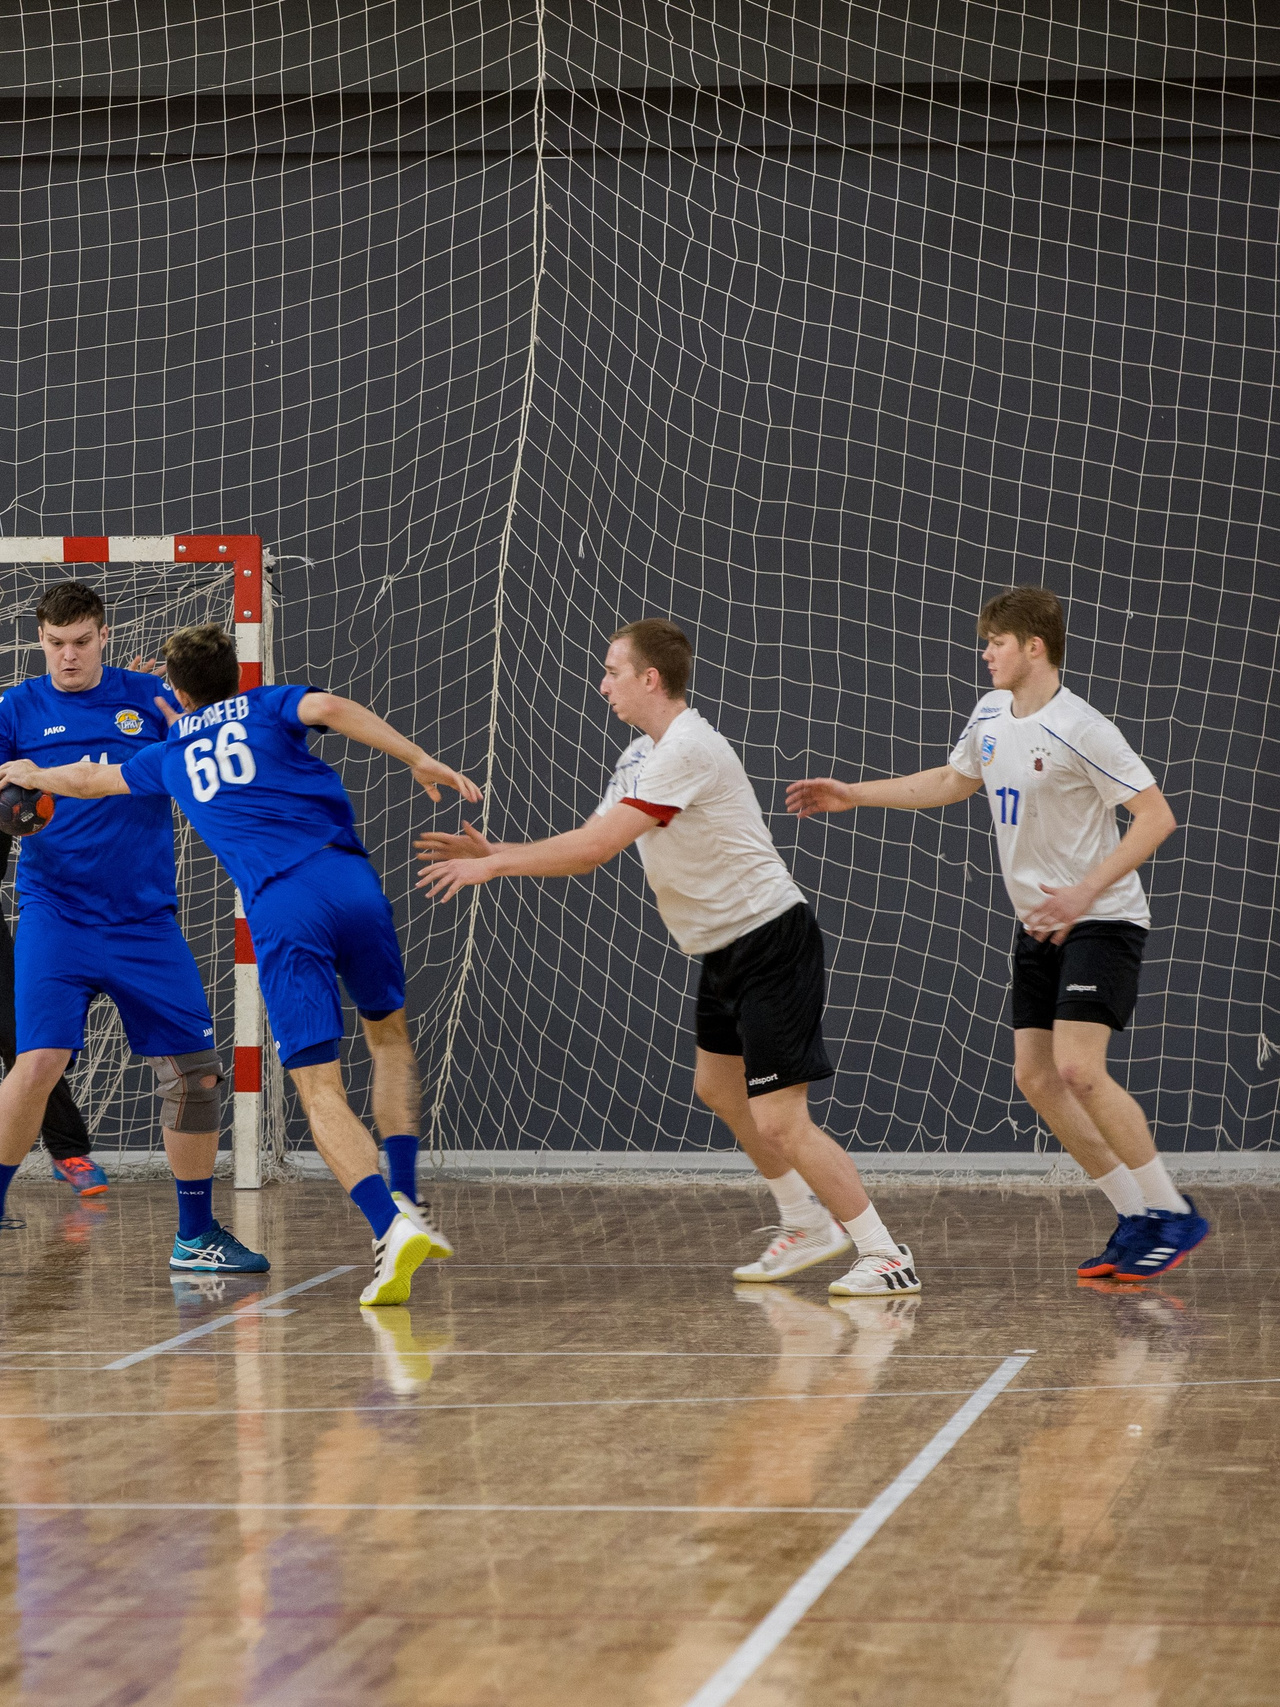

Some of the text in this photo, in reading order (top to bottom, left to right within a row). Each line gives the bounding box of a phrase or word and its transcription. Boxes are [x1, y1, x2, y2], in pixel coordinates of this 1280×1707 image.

[43, 725, 66, 736] JAKO
[184, 721, 257, 803] 66
[995, 786, 1020, 826] 17
[748, 1073, 778, 1086] uhlsport
